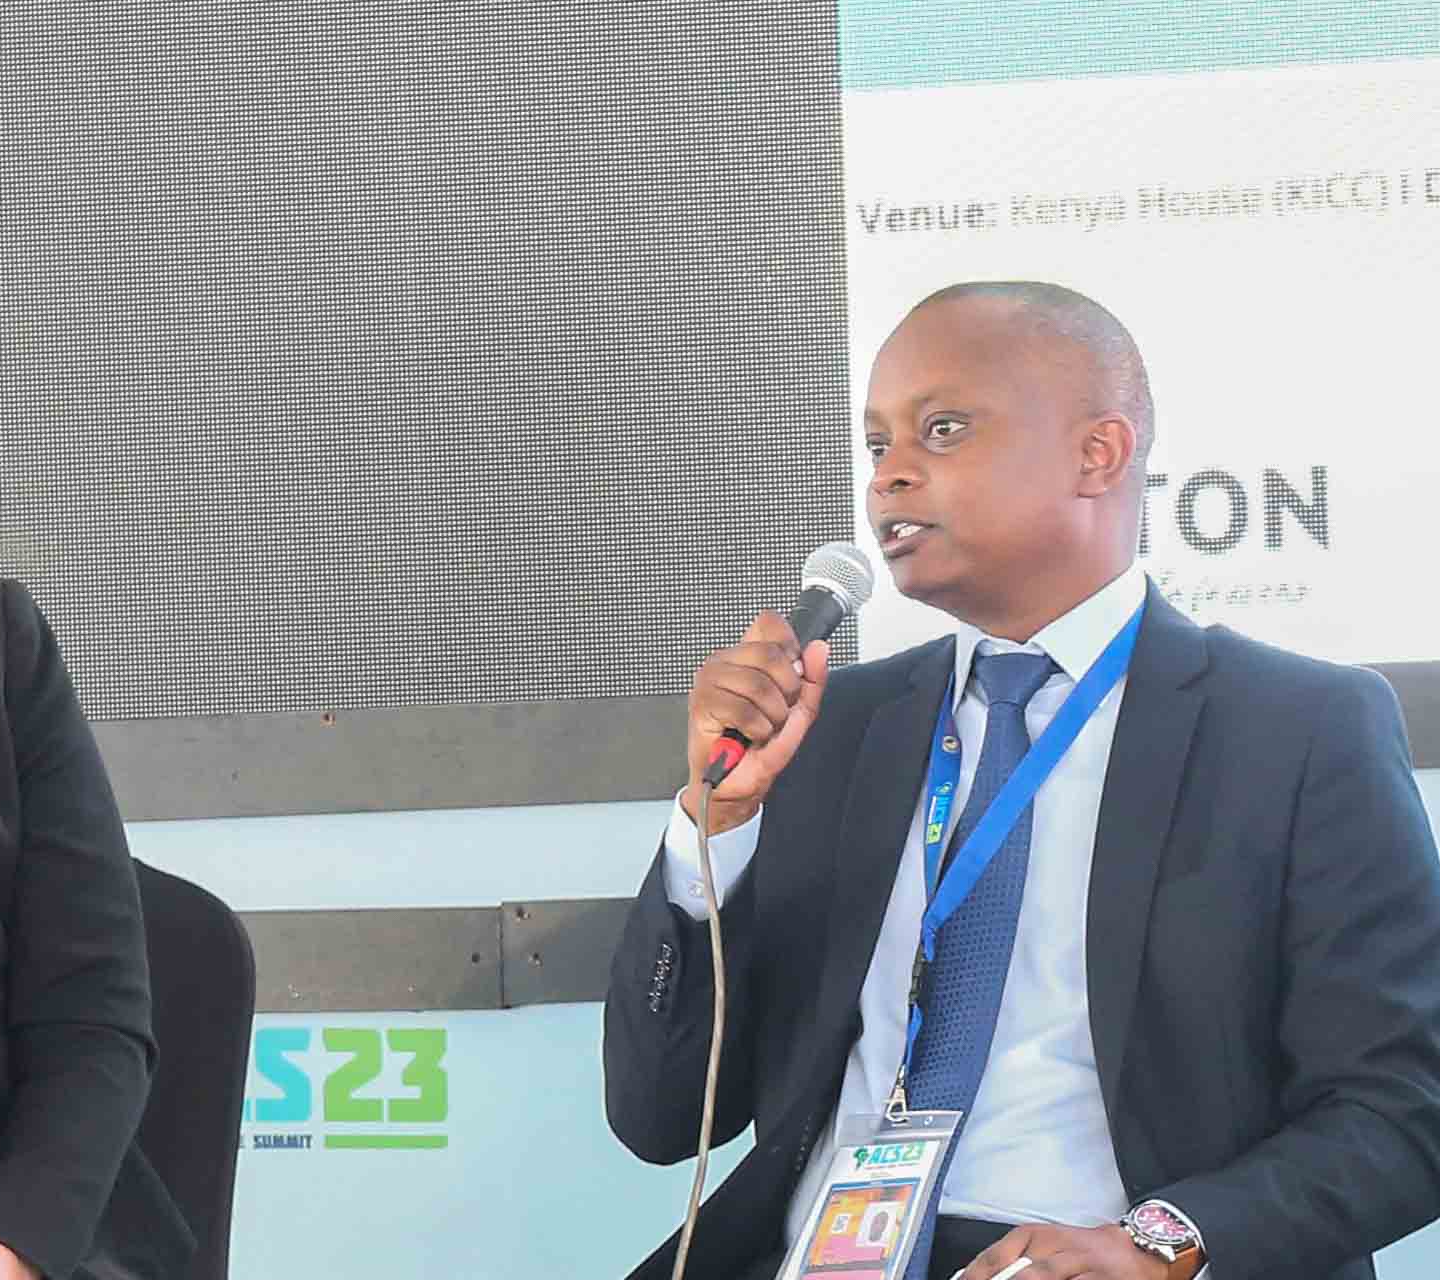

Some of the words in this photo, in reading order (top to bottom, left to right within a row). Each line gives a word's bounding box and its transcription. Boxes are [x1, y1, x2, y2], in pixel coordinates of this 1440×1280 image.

[859, 196, 997, 236] Venue:
[1010, 190, 1126, 231] Kenya
[1138, 182, 1261, 223] House
[1274, 170, 1390, 217] (KICC)
[1139, 465, 1330, 557] TON
[246, 1028, 448, 1122] S23
[253, 1134, 312, 1149] SUMMIT
